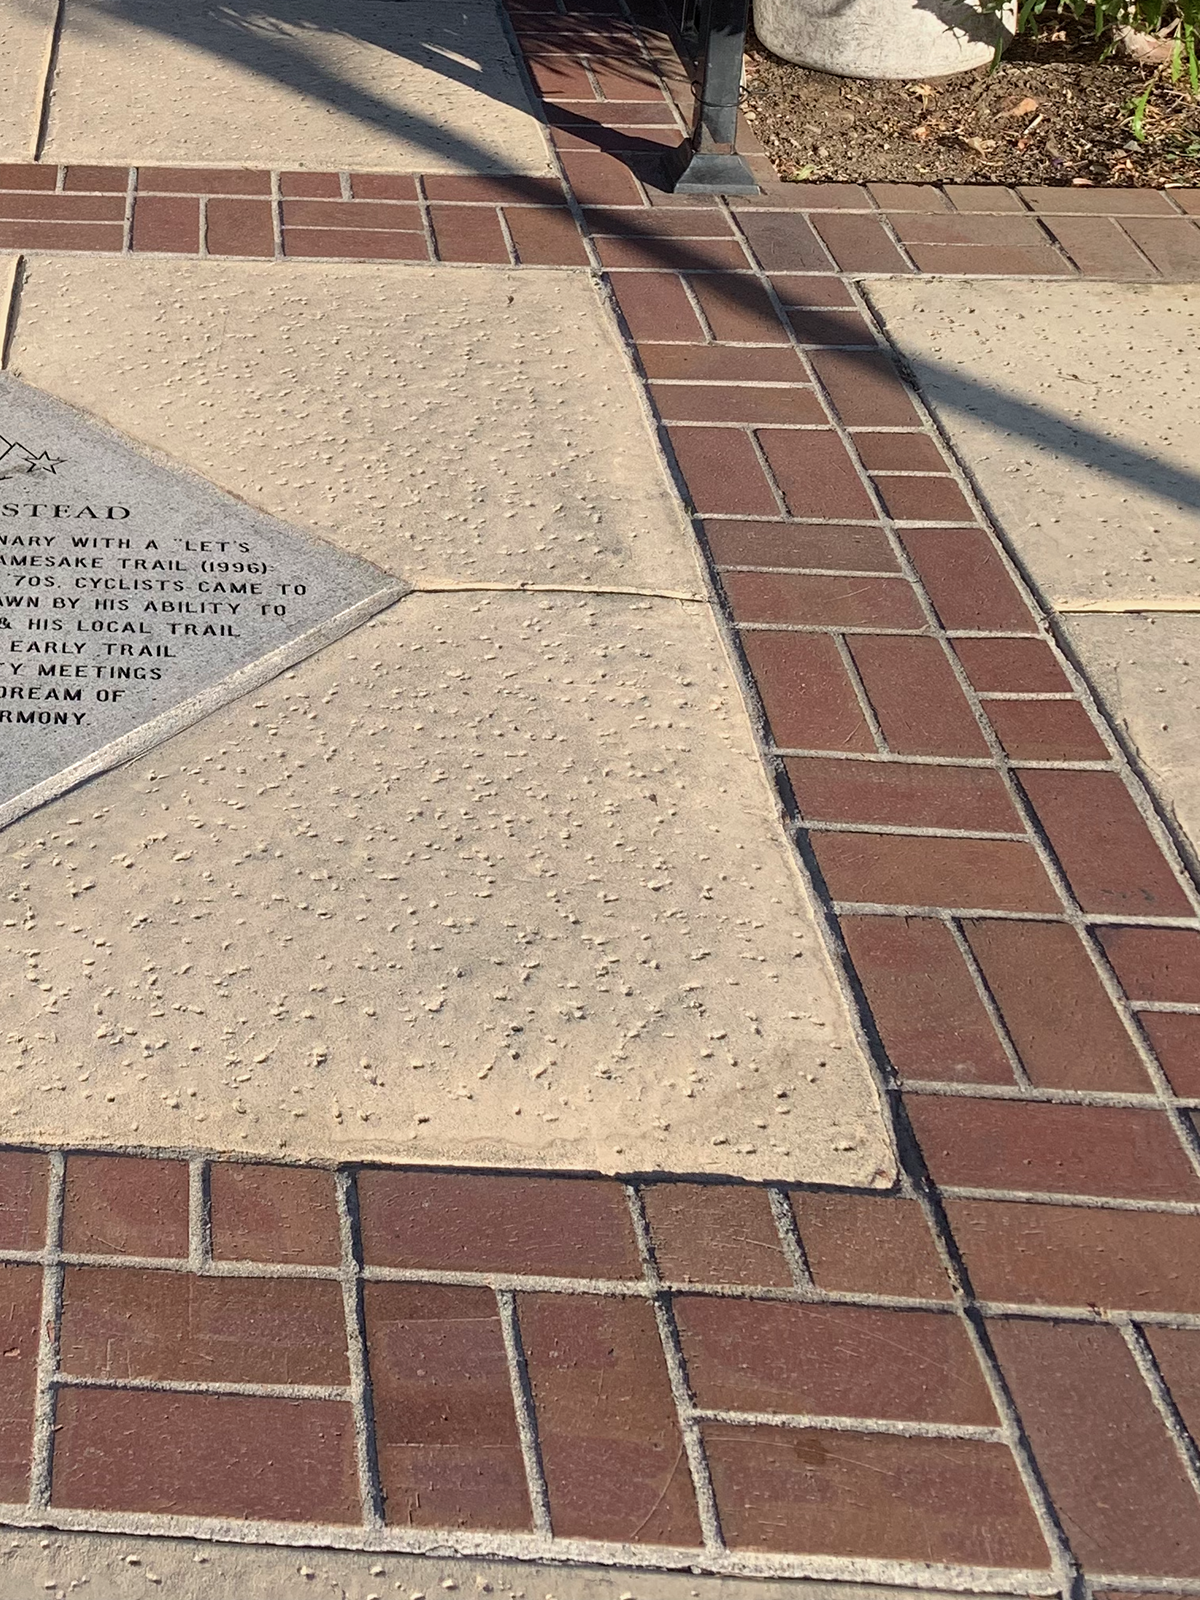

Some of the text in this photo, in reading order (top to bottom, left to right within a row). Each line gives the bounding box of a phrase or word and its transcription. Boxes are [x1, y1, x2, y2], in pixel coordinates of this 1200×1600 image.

[71, 536, 130, 549] WITH
[144, 539, 159, 550] A
[122, 558, 187, 572] TRAIL
[198, 580, 263, 595] CAME
[276, 583, 307, 596] TO
[52, 596, 80, 610] BY
[94, 598, 129, 611] HIS
[143, 600, 241, 615] ABILITY
[261, 604, 286, 617] TO
[28, 618, 63, 631] HIS
[77, 619, 152, 634] LOCAL
[170, 622, 241, 639] TRAIL
[10, 640, 87, 655] EARLY
[102, 643, 177, 658] TRAIL
[37, 663, 162, 681] MEETINGS
[96, 689, 126, 703] OF
